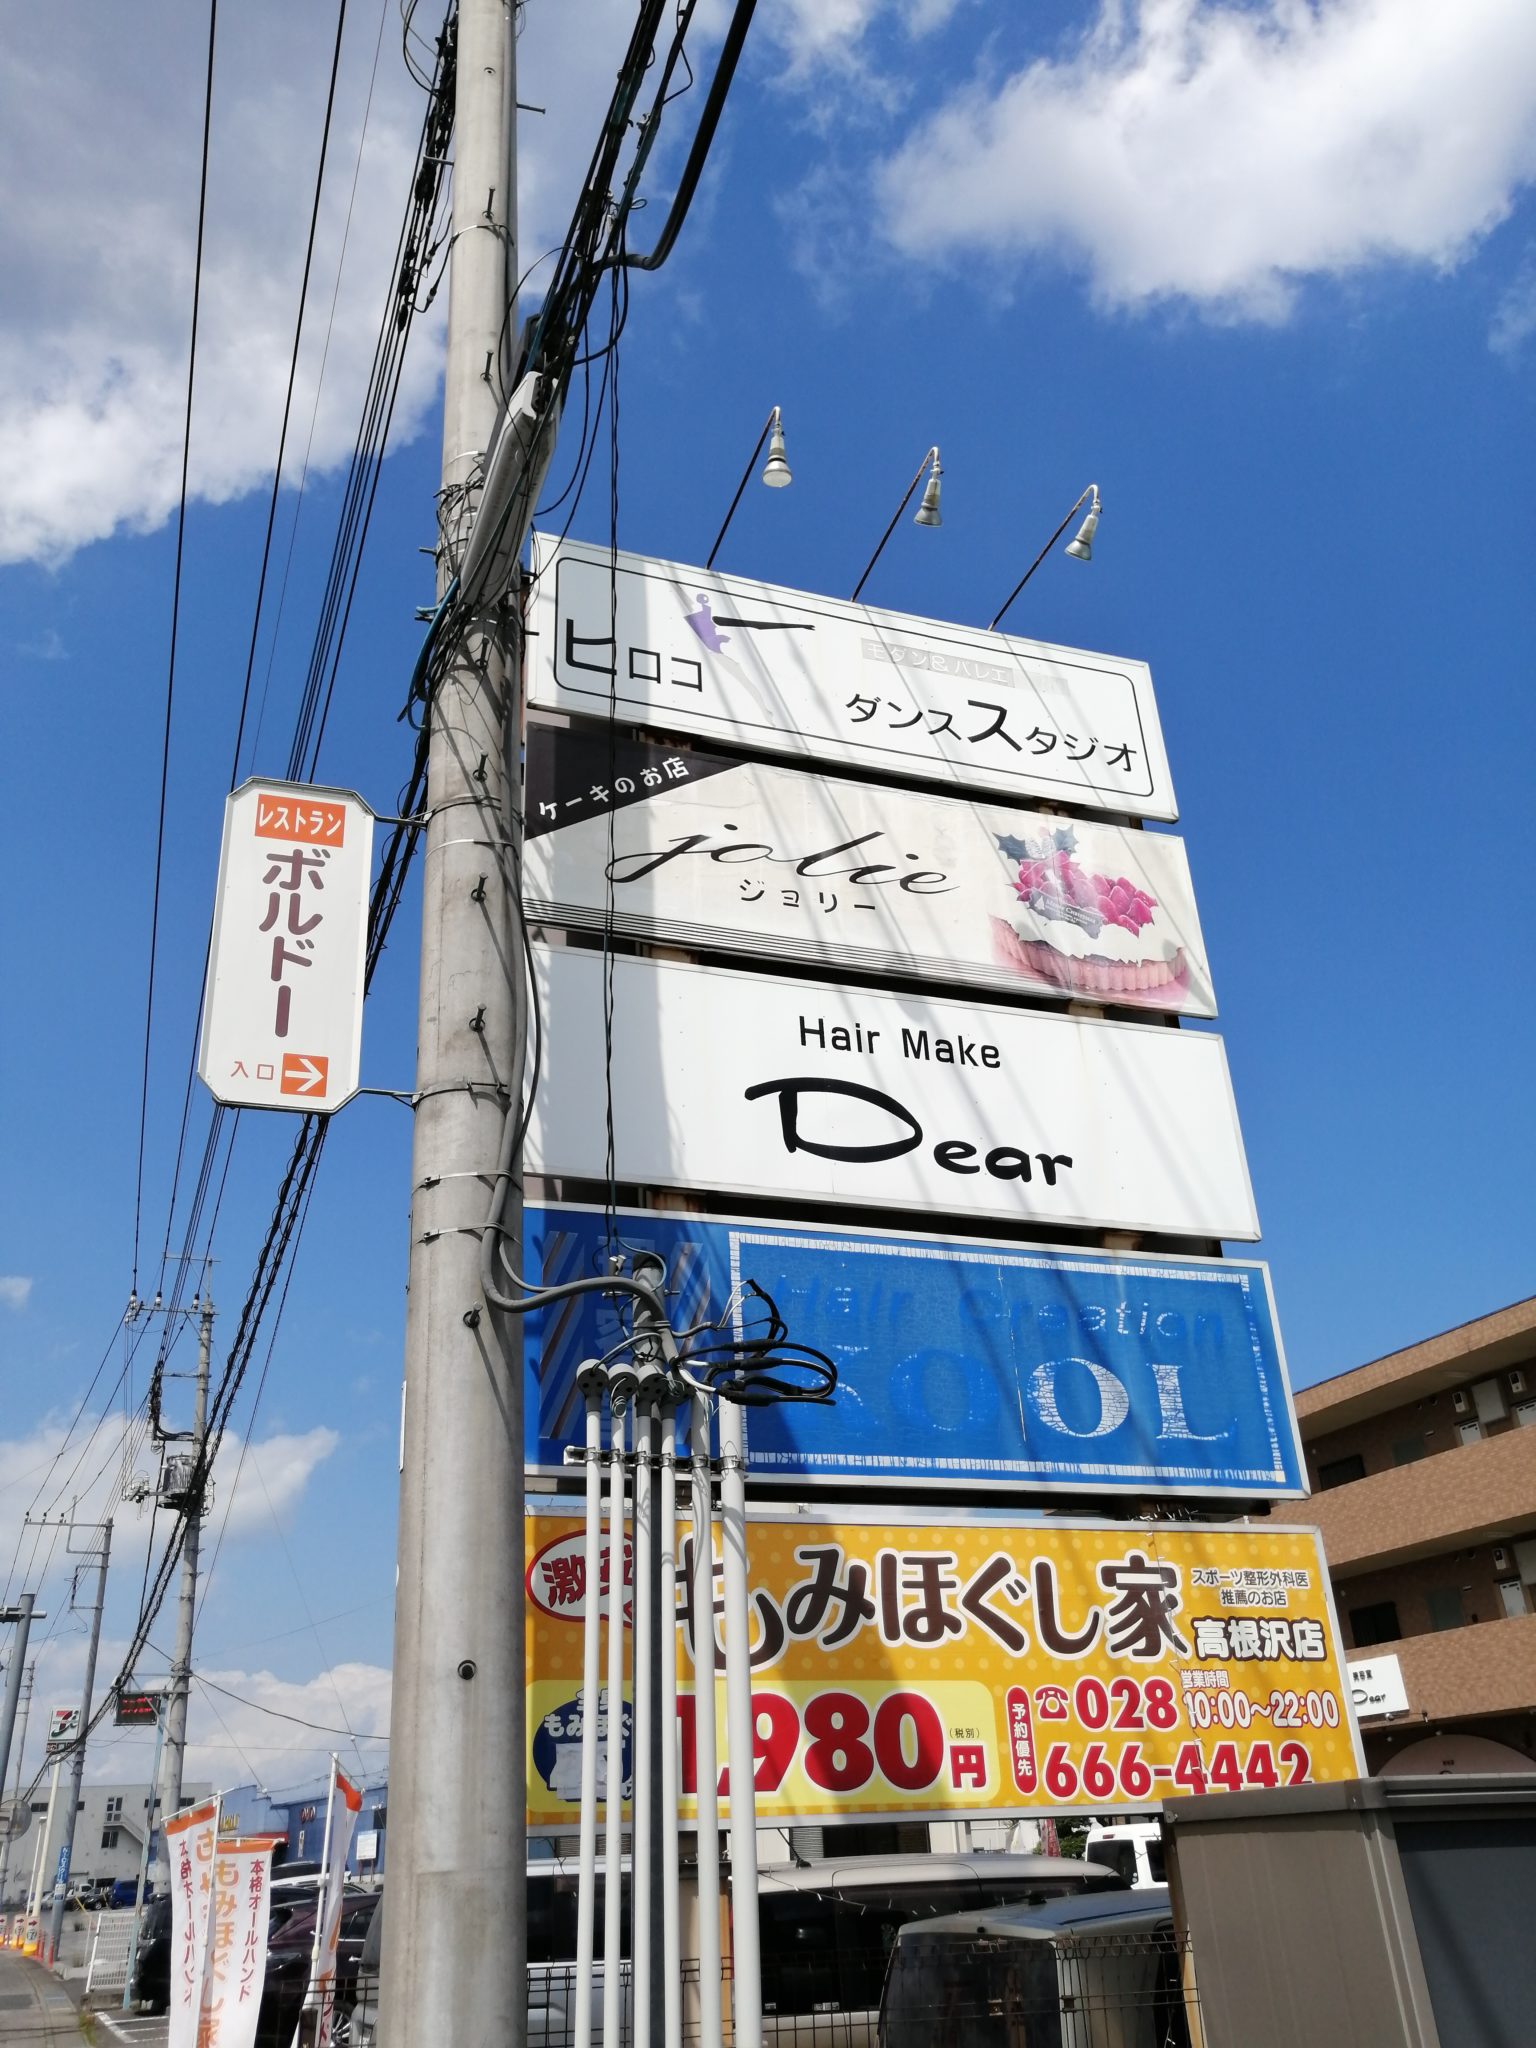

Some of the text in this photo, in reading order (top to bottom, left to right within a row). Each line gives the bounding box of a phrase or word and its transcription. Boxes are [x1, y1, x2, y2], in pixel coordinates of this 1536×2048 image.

[565, 617, 703, 692] ヒロコ
[845, 692, 1138, 773] ダンススタジオ
[538, 756, 690, 820] ケーキのお店
[258, 803, 342, 837] レストラン
[604, 823, 961, 894] jolie
[739, 879, 876, 913] ジョリー
[258, 848, 332, 1038] ボルドー
[799, 1015, 1002, 1069] Hair Make
[231, 1060, 275, 1081] 入口
[744, 1076, 1073, 1187] Dear
[675, 1537, 1190, 1672] もみほぐし家
[1191, 1568, 1310, 1588] スポーツ整形外科医
[1220, 1588, 1287, 1607] 推薦のお店
[1193, 1618, 1326, 1659] 高根沢店
[1075, 1678, 1178, 1730] 028
[1180, 1669, 1231, 1689] 営業時間
[949, 1727, 981, 1740] (税別)
[1011, 1703, 1034, 1777] 予約優先
[1045, 1742, 1314, 1798] 666-4442
[239, 1858, 265, 2003] 本格オールハンド
